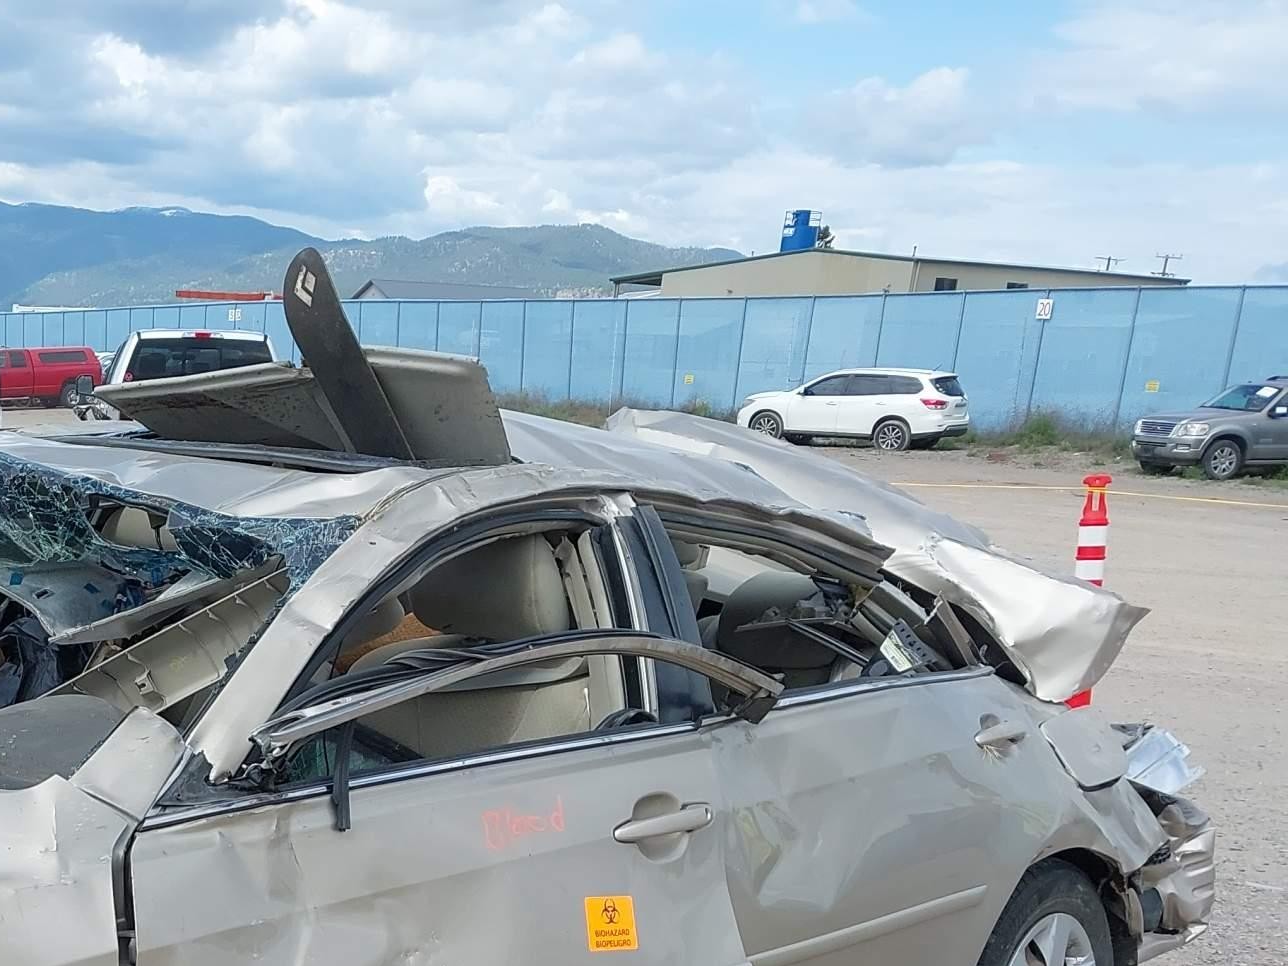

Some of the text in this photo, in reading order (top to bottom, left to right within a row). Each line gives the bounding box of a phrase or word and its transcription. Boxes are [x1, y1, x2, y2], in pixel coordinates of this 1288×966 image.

[1037, 302, 1051, 317] 20
[594, 928, 630, 938] BIOHAZARD
[595, 938, 632, 948] BIOPELIGRO
